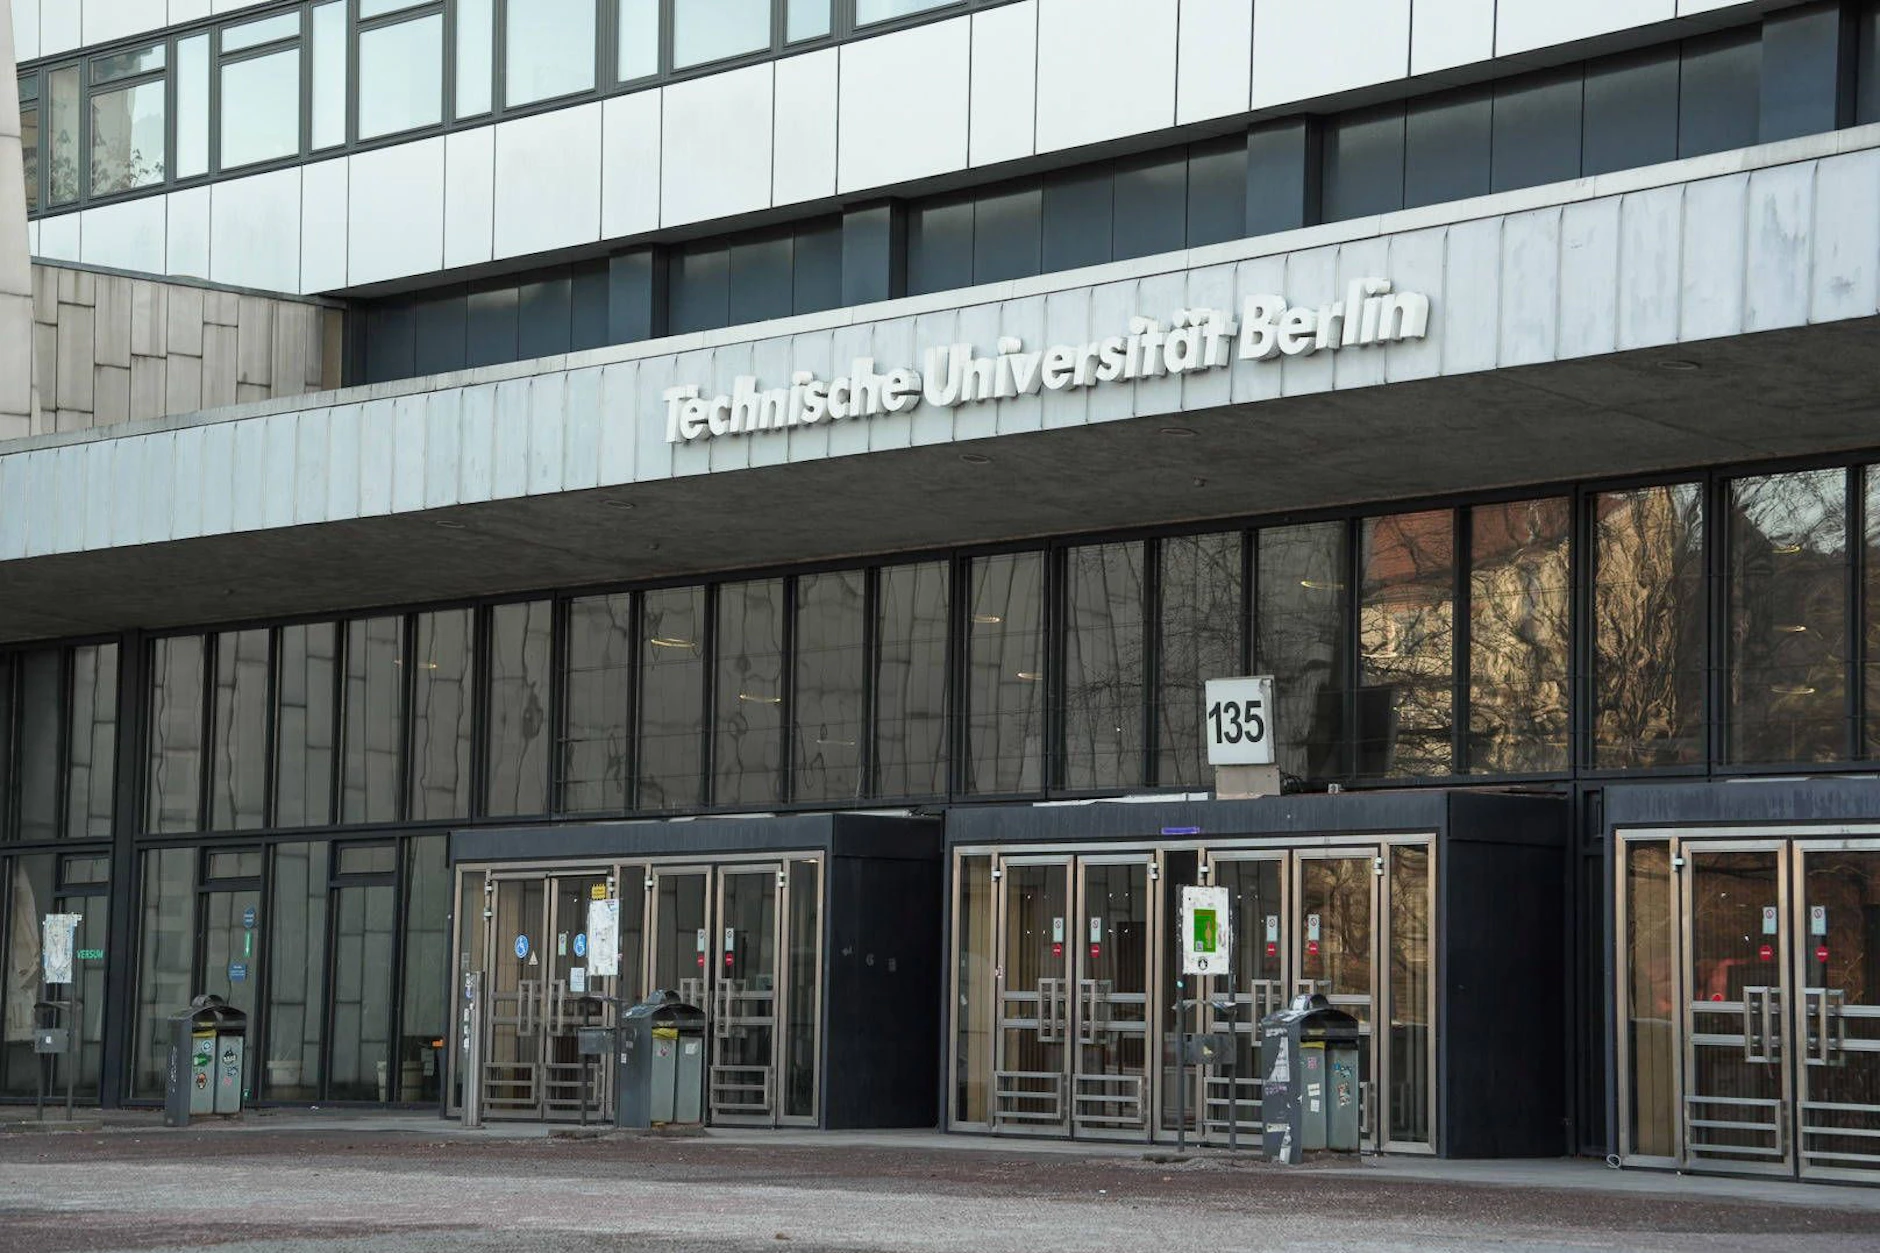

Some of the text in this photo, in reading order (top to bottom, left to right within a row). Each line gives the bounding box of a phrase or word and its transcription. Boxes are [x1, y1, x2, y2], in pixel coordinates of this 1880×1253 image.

[663, 277, 1429, 443] Technische Universität Berlin
[1209, 700, 1264, 744] 135
